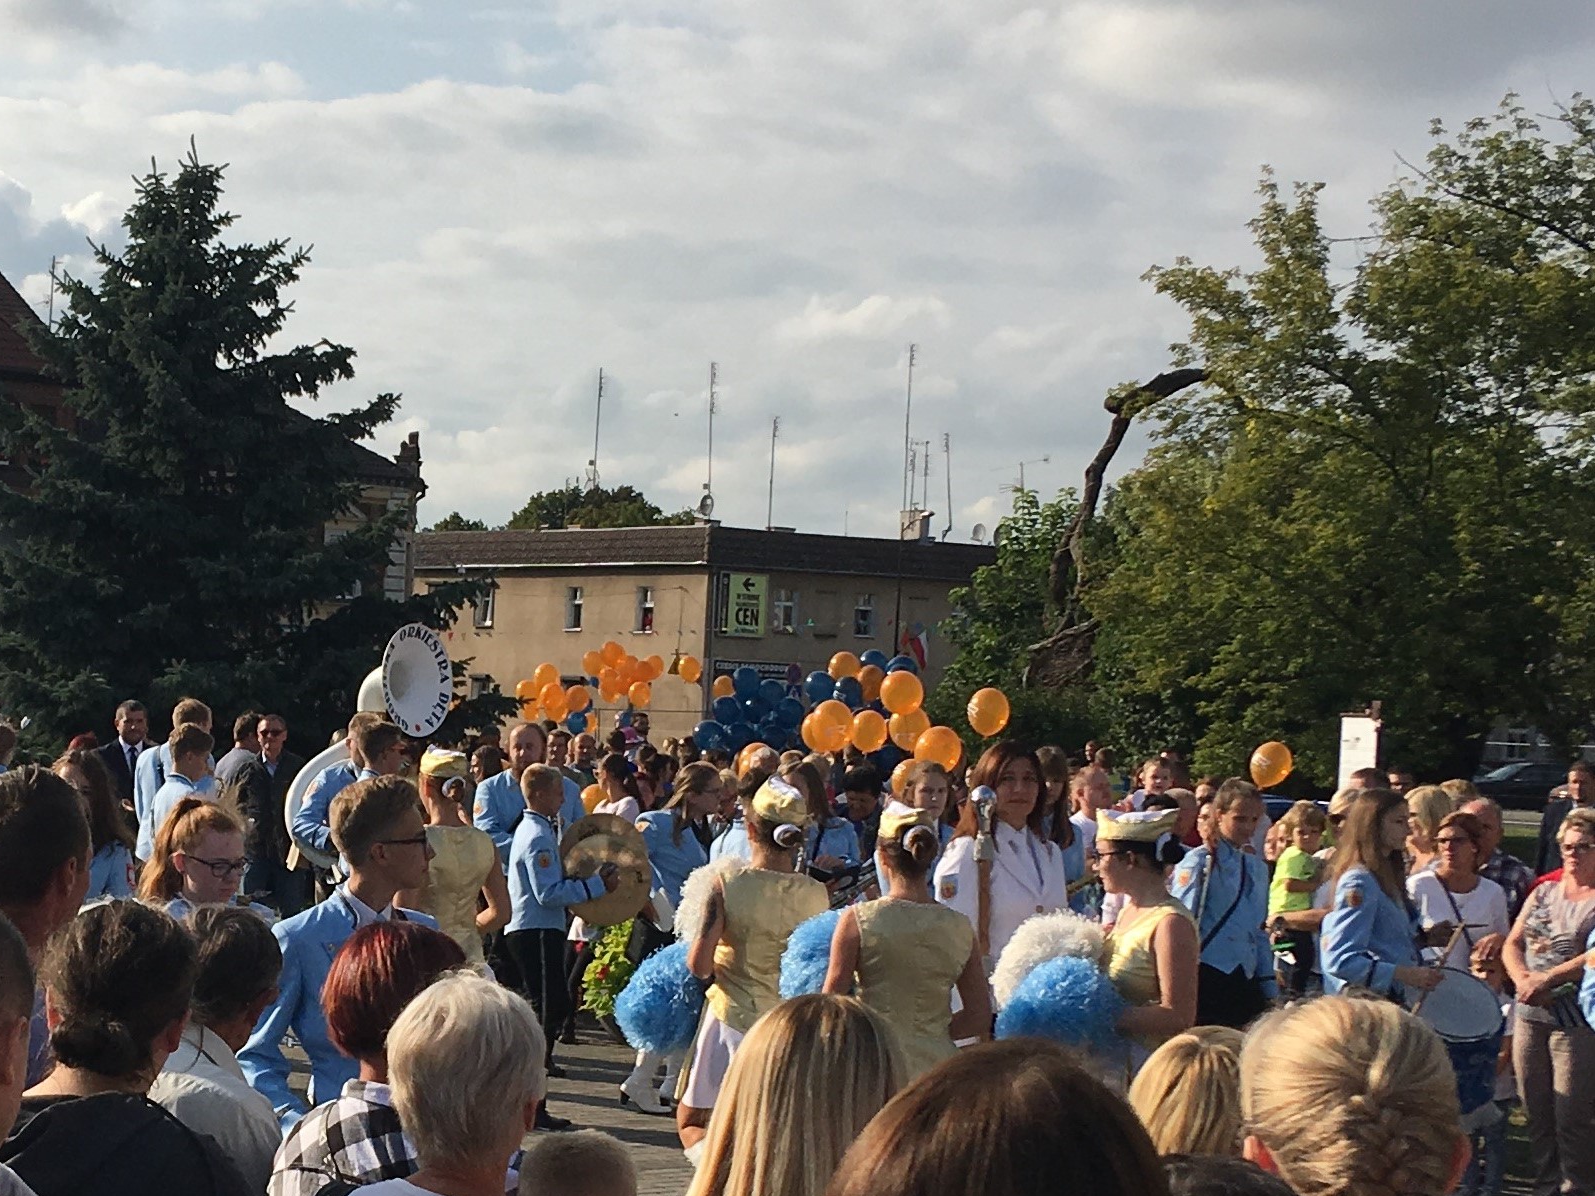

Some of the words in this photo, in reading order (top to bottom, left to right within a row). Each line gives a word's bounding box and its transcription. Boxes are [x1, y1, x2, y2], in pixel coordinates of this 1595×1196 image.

[735, 607, 759, 626] CEN
[399, 626, 449, 684] ORKIESTRA
[425, 691, 449, 728] DĘTA
